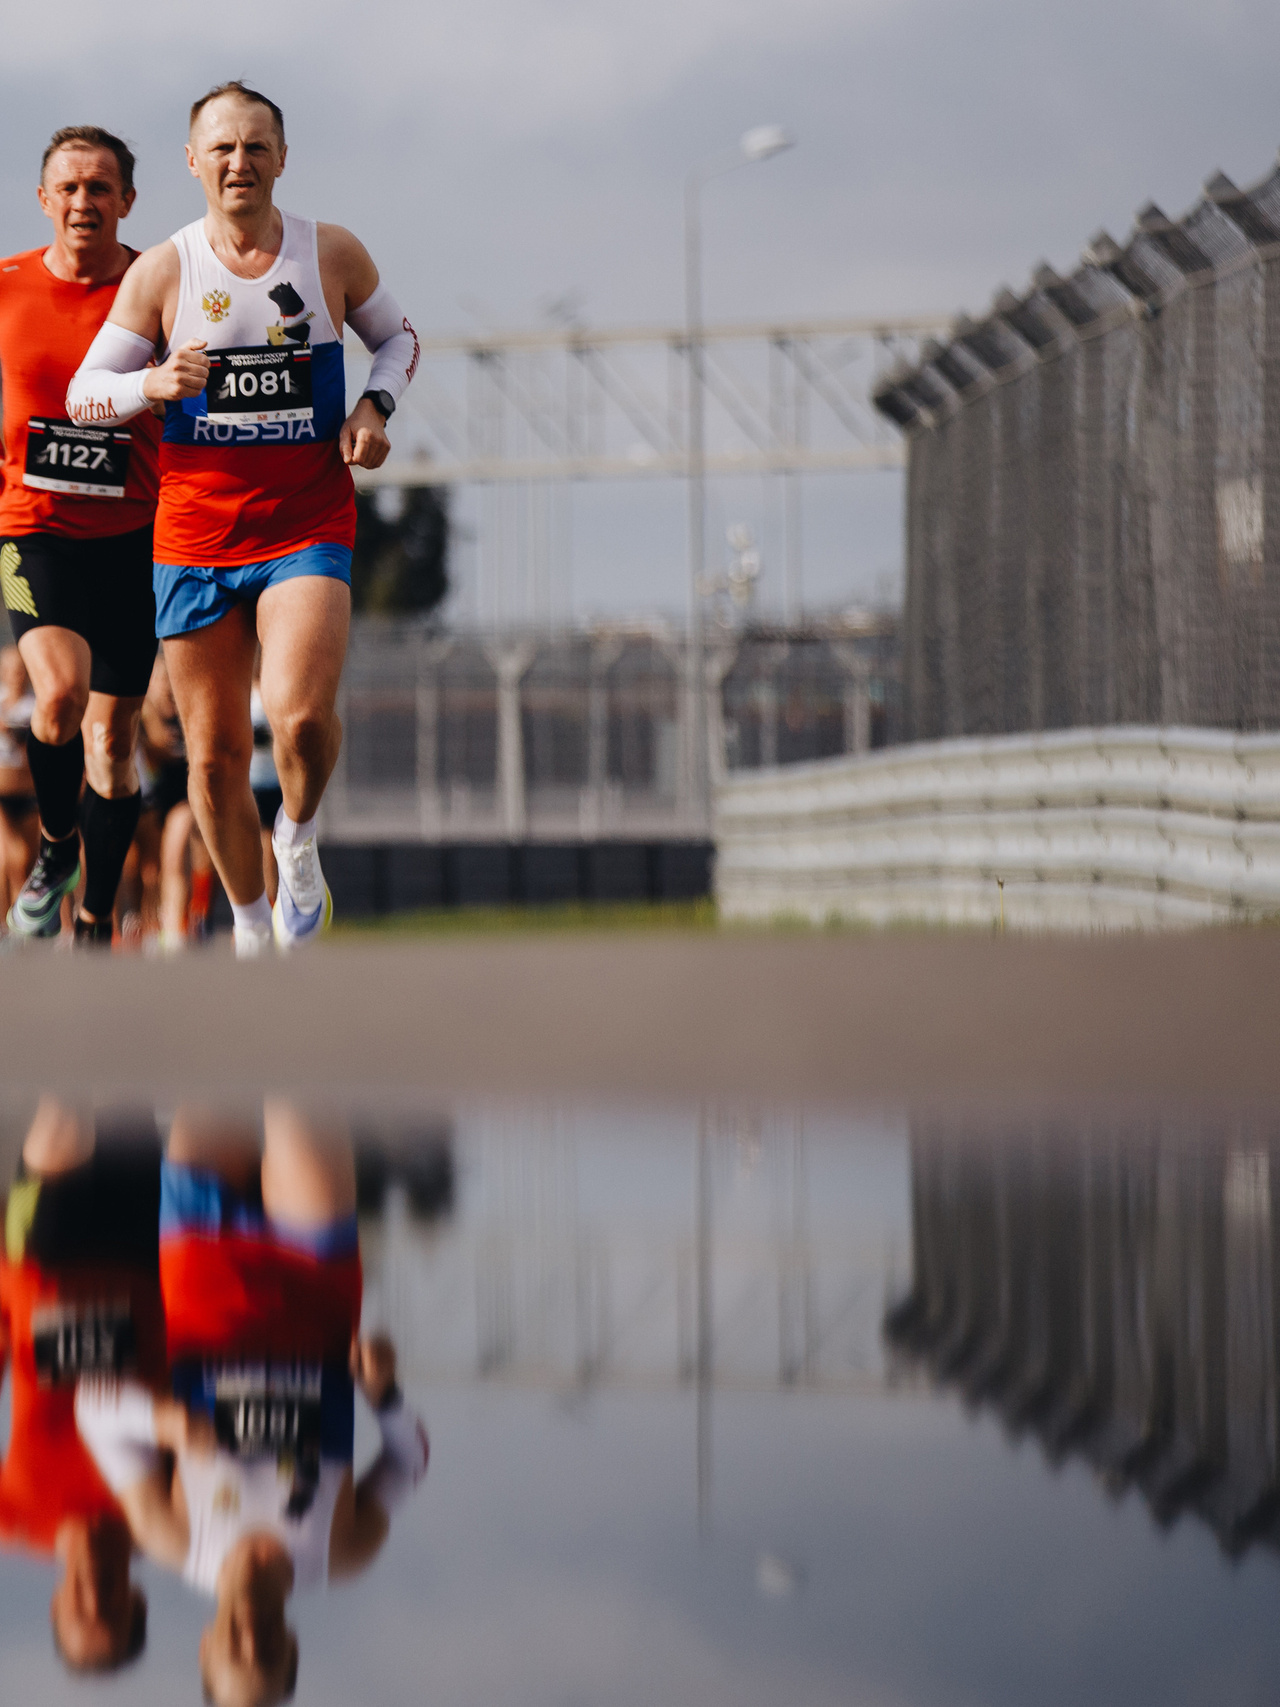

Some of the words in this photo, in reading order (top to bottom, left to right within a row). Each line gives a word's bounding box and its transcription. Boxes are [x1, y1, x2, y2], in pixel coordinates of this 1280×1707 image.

[225, 369, 291, 398] 1081
[193, 416, 316, 441] RUSSIA
[47, 441, 108, 470] 1127
